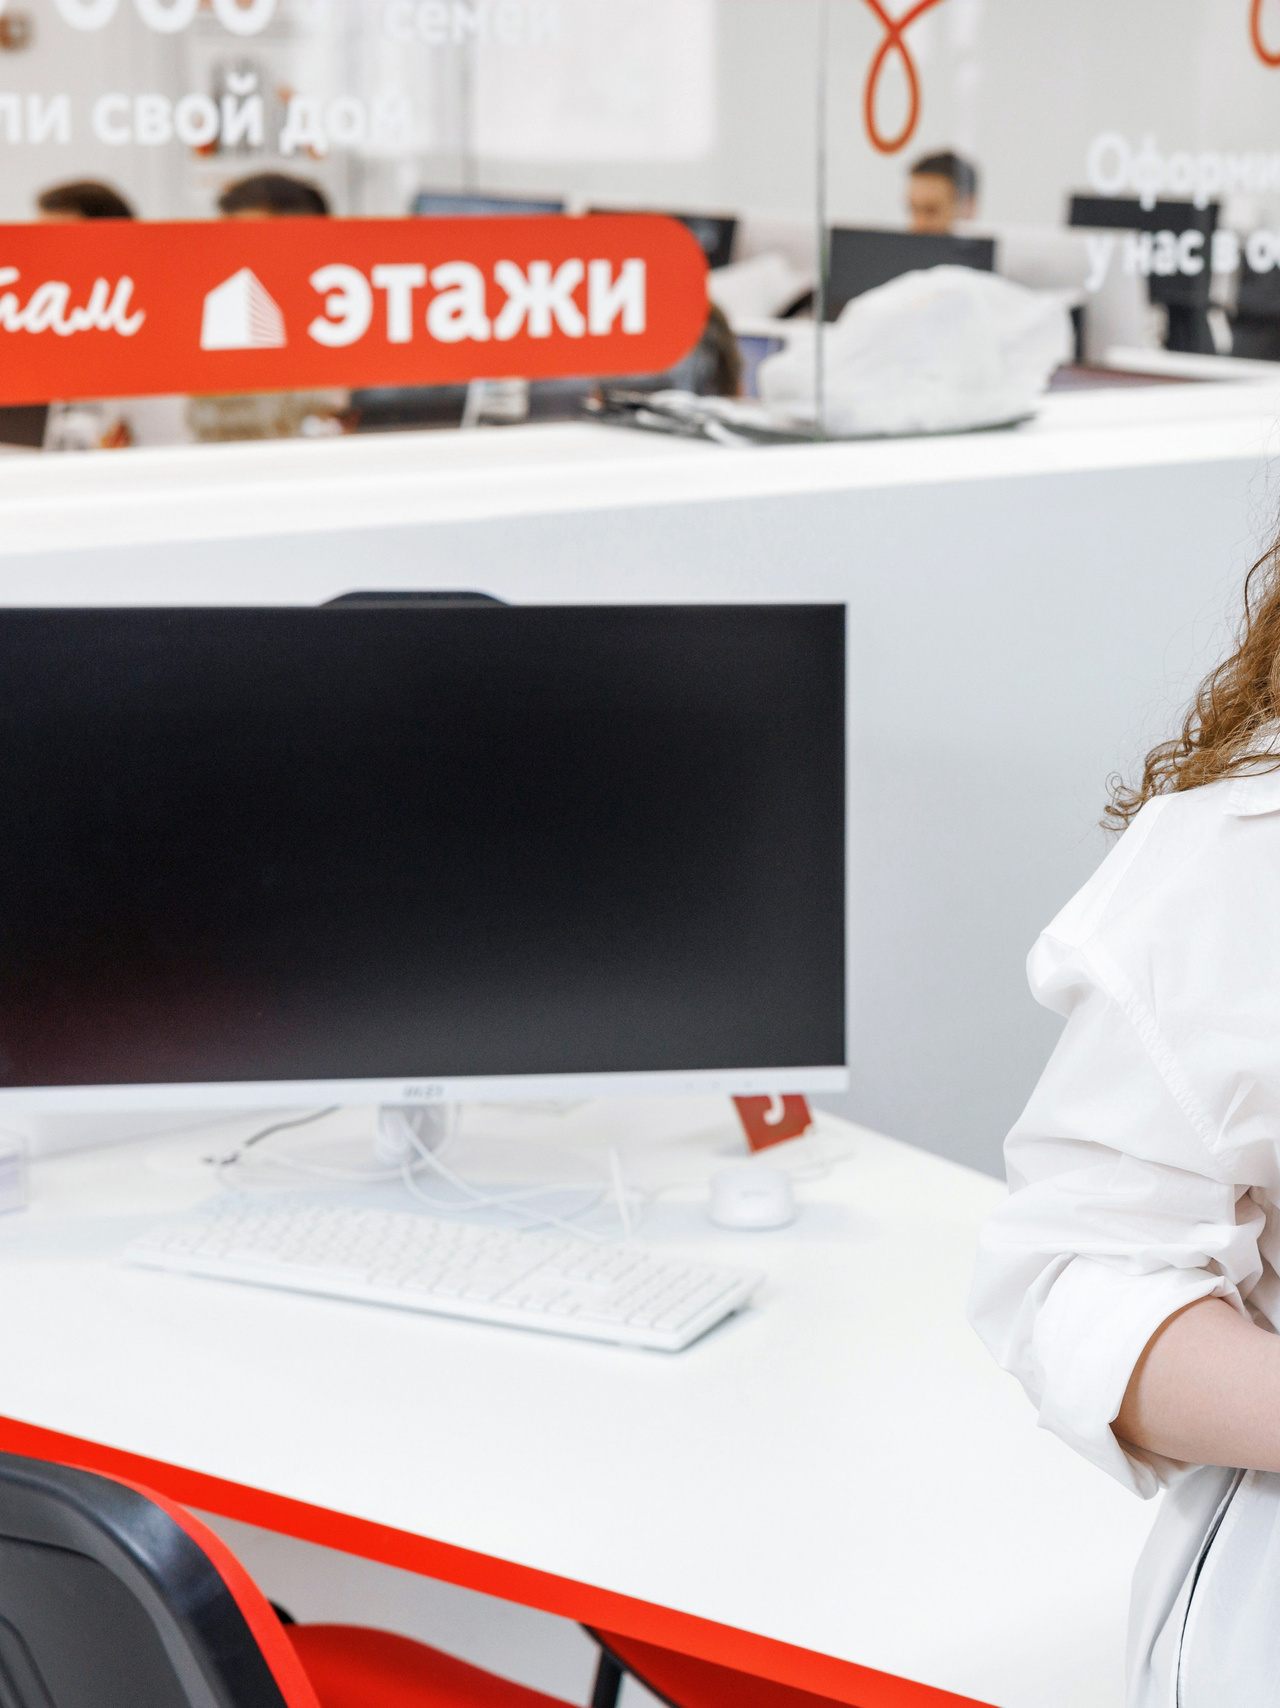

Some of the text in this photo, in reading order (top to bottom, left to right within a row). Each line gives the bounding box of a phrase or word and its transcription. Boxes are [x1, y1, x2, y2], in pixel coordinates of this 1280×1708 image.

[92, 76, 262, 145] свой
[279, 93, 413, 156] дом
[1123, 228, 1205, 276] нас
[1210, 229, 1239, 275] в
